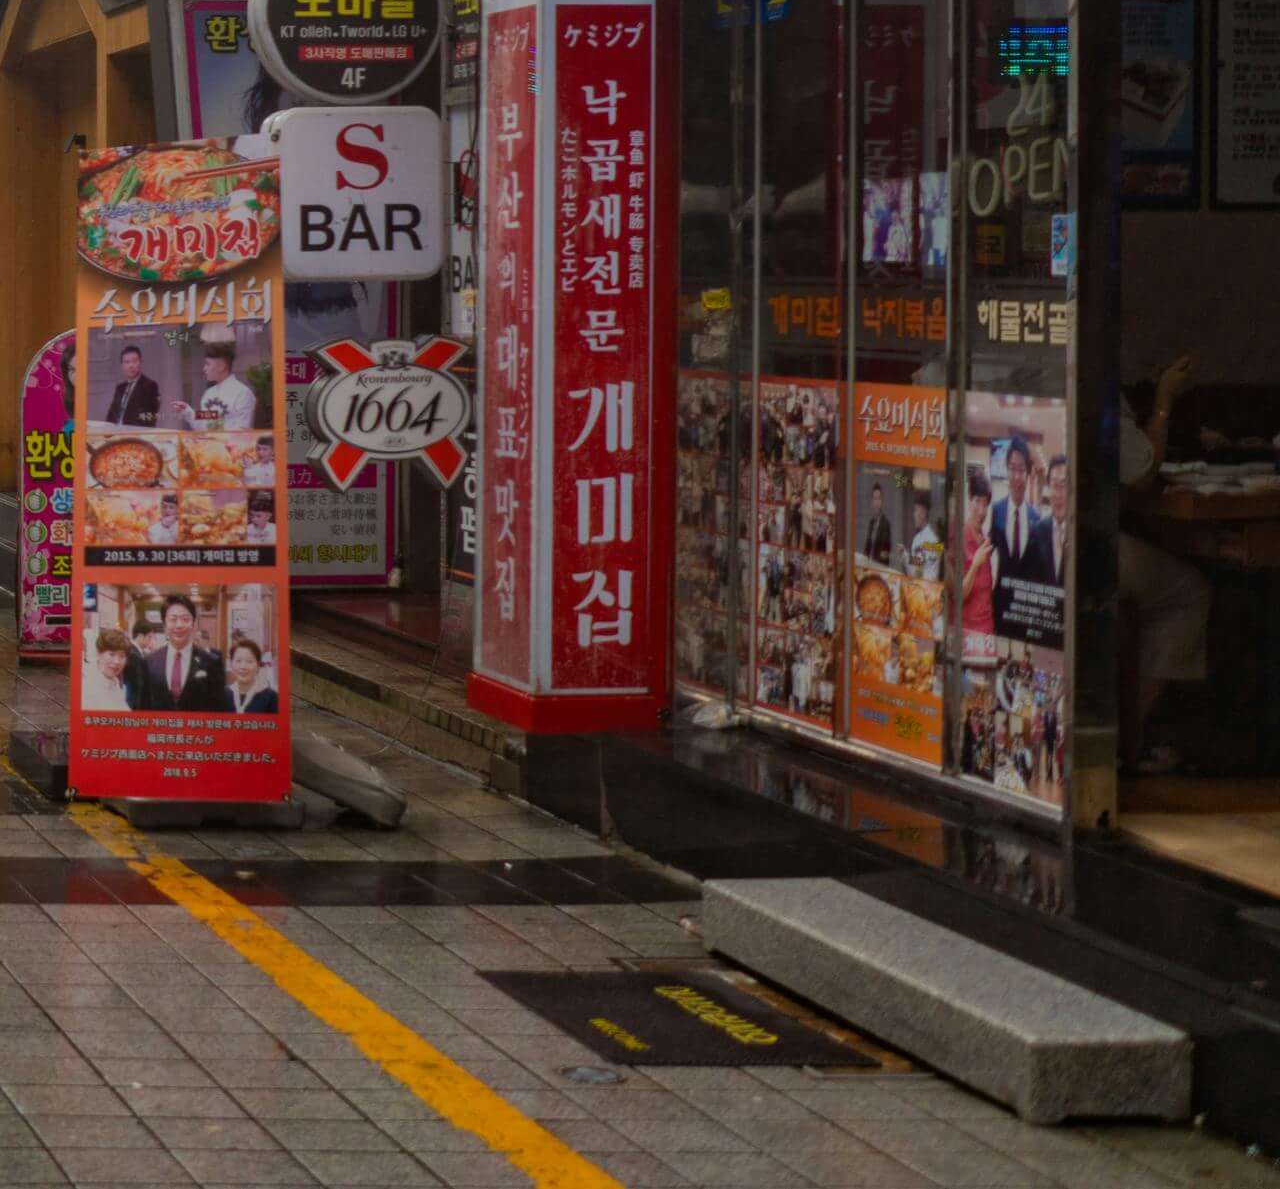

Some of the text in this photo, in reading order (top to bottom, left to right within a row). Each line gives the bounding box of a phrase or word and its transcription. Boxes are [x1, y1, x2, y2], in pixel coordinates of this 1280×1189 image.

[279, 24, 296, 39] KT
[562, 21, 645, 50] ケミジプ
[340, 67, 367, 89] 4F
[335, 123, 390, 190] S
[120, 215, 261, 263] 개미집
[299, 203, 424, 253] BAR
[579, 79, 627, 353] 낙곱새전문
[90, 276, 272, 333] 수요미식회
[768, 296, 841, 339] 개미집
[976, 297, 1070, 344] 해물전골
[354, 372, 434, 390] Kronenbourg
[343, 384, 447, 435] 1664
[566, 380, 636, 650] 개미집
[104, 549, 134, 563] 2015.
[151, 549, 166, 563] 30
[202, 549, 236, 564] 개미집
